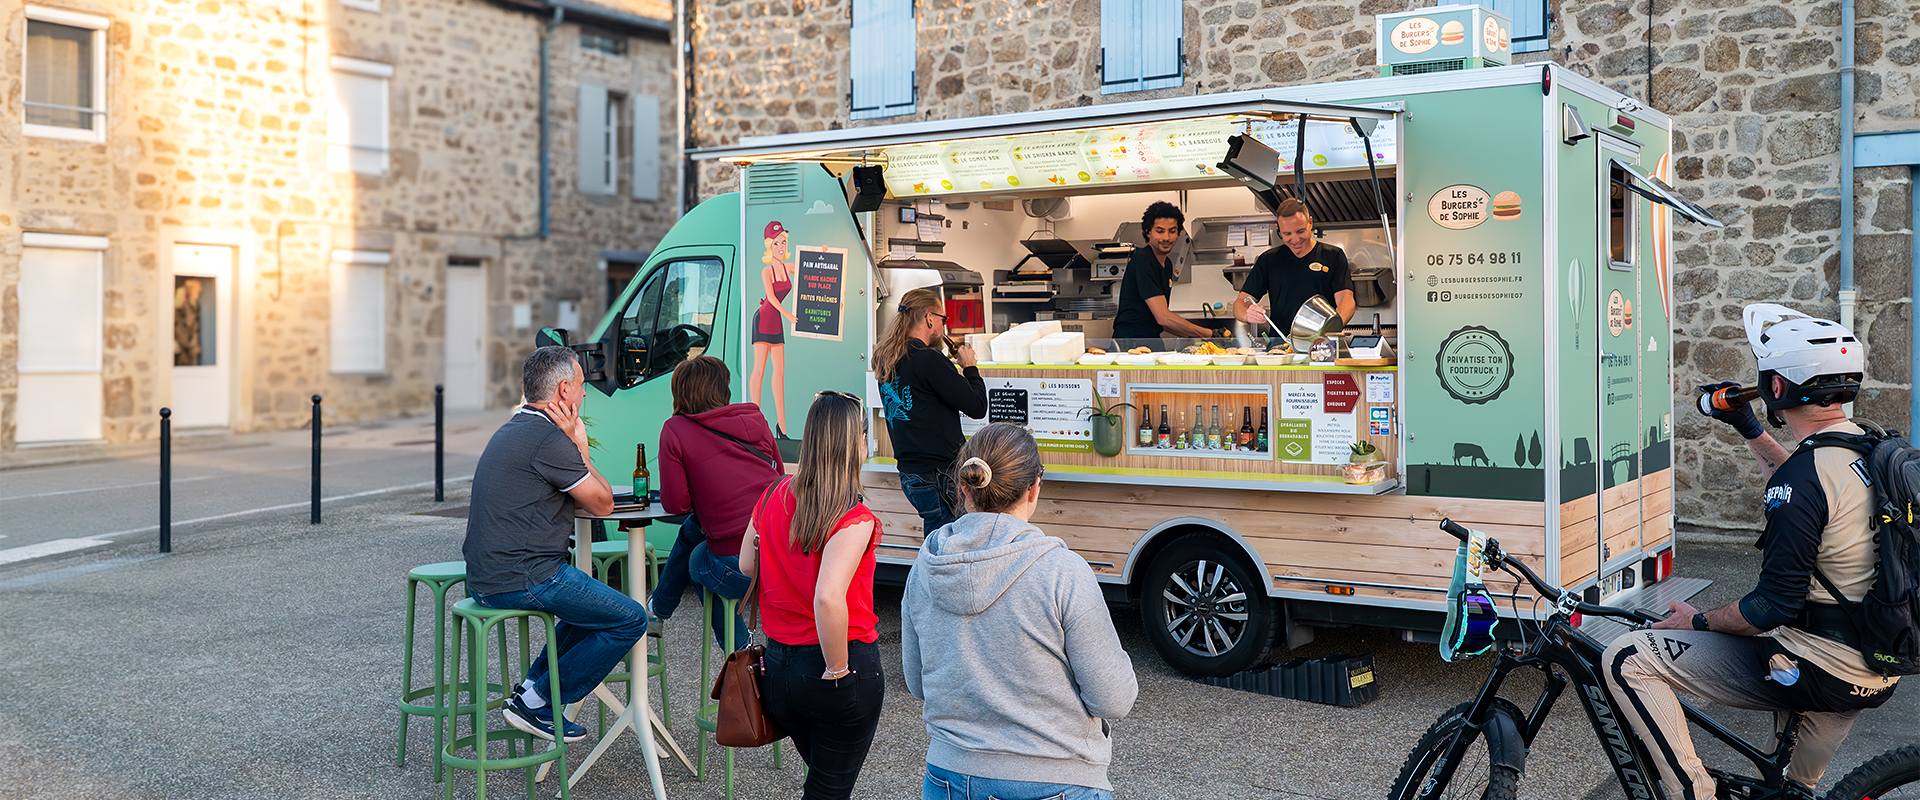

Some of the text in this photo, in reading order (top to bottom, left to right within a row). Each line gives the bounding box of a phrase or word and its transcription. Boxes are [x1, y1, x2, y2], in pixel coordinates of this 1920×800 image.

[1401, 31, 1430, 39] BURGERS
[1409, 38, 1431, 47] SOPHIE
[1451, 190, 1467, 199] LES
[1441, 200, 1478, 210] BURGERS
[1439, 211, 1480, 221] DE SOPHIE
[1427, 252, 1521, 266] 06 75 64 98 11
[1441, 276, 1523, 284] LESBURGERSDESOPHIE.FR
[1454, 292, 1523, 300] BURGERSDESOPHIE07
[1447, 355, 1503, 364] PRIVATISE TON
[1449, 366, 1493, 375] FOODTRUCK
[1766, 483, 1793, 503] REPAIR
[1645, 632, 1664, 661] SUPERT
[1582, 683, 1651, 800] SANTA CR
